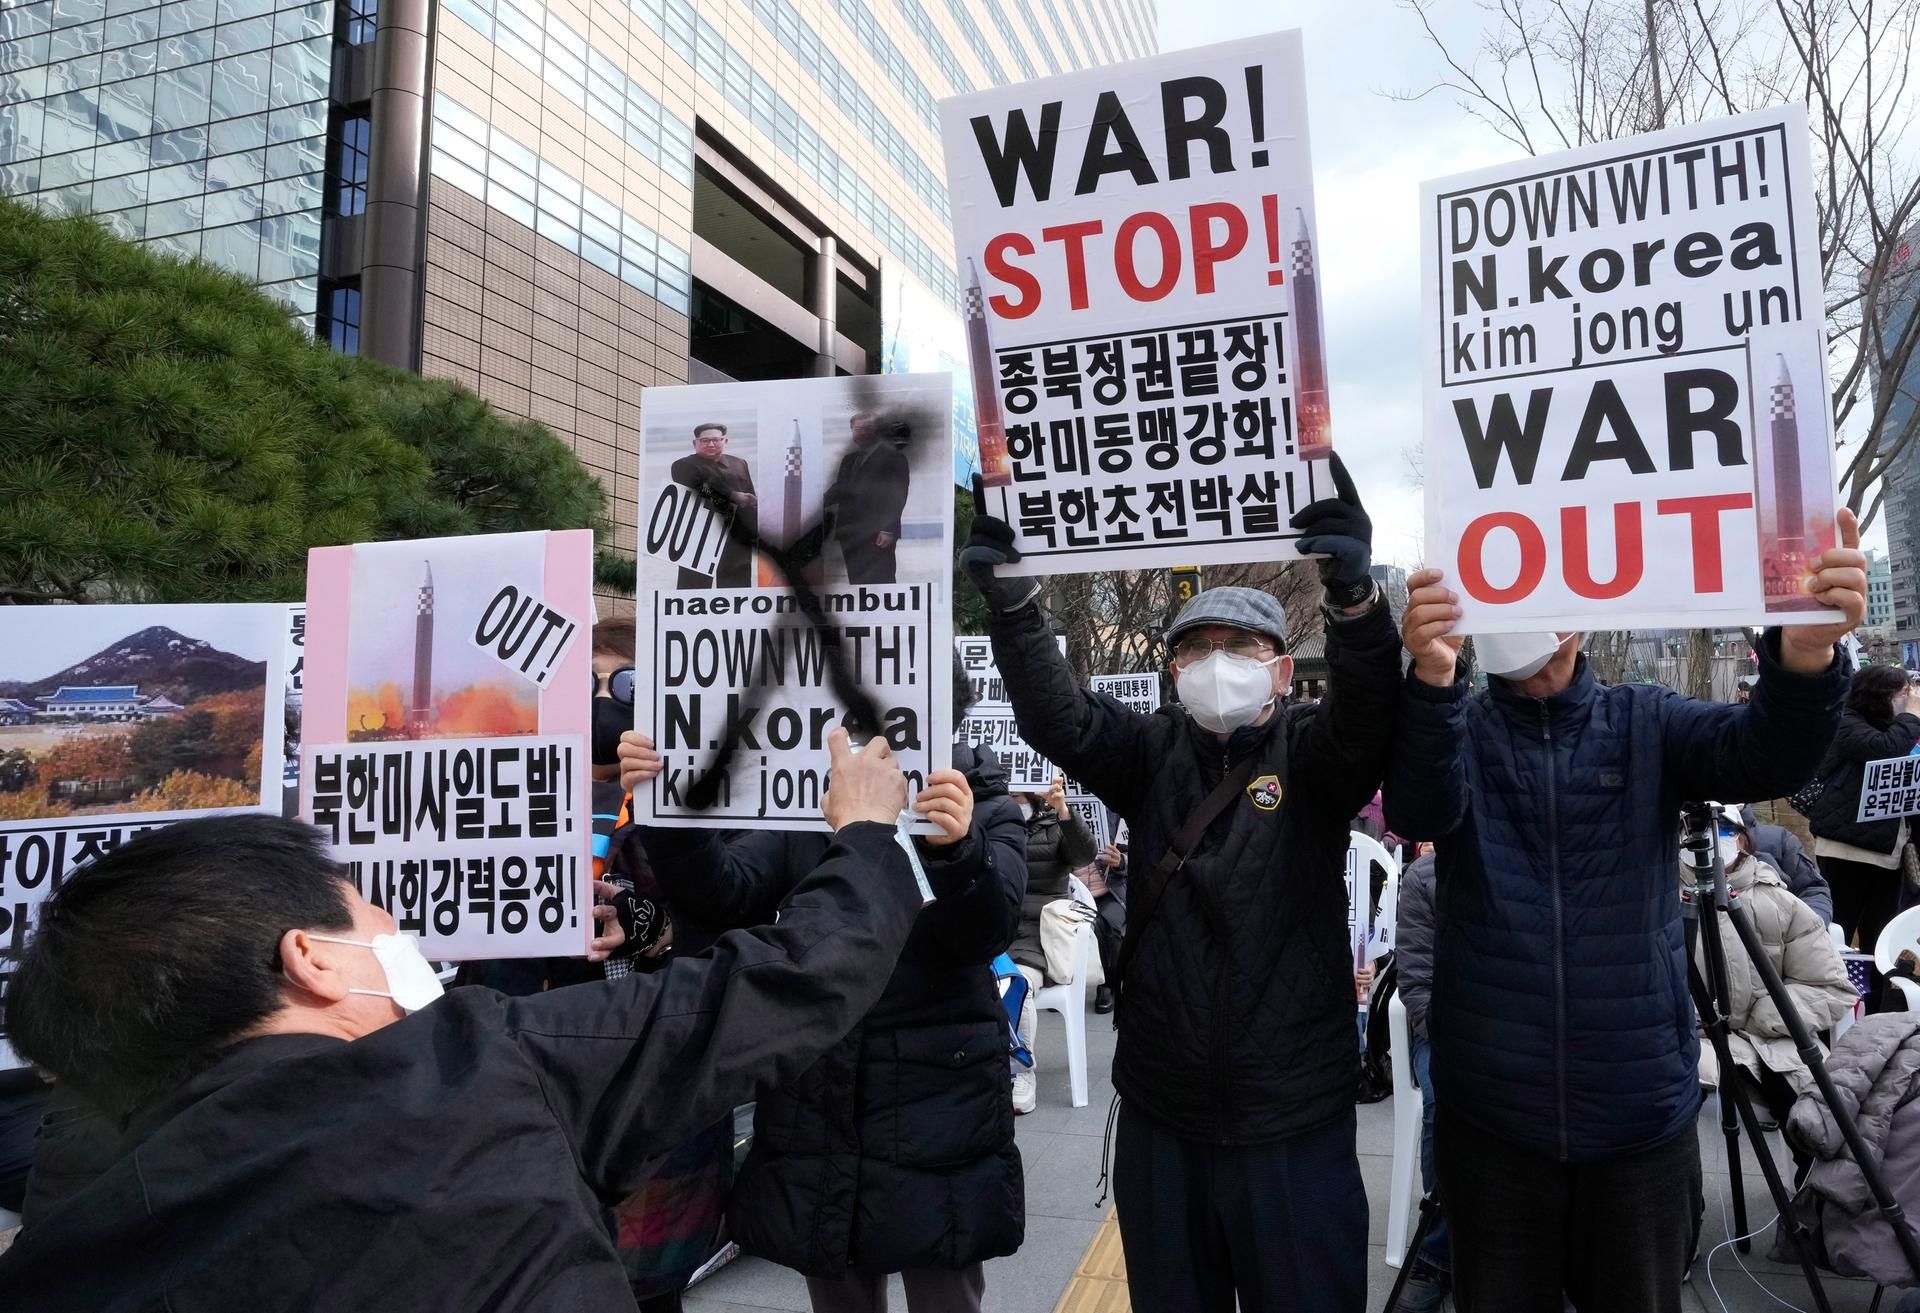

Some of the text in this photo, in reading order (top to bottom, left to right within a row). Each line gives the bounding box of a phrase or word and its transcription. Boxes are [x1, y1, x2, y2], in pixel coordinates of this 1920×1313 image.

[969, 64, 1271, 208] WAR!
[982, 194, 1284, 320] STOP!
[1452, 221, 1782, 316] N.korea
[999, 322, 1286, 414] 종북정권끝장!
[1453, 285, 1789, 374] kim jong un
[1006, 397, 1294, 482] 한미동맹강화!
[1452, 368, 1748, 489] WAR
[1018, 470, 1296, 548] 북한초전박살!
[1457, 493, 1752, 604] OUT
[475, 585, 576, 683] OUT!
[665, 586, 921, 617] naeronmbul
[1179, 580, 1192, 600] 3
[791, 626, 917, 687] WTH!
[312, 744, 572, 845] 북한미사일도발!
[758, 756, 831, 817] jon
[1864, 789, 1920, 818] 온국민끝
[341, 853, 577, 938] 사회강력응징!
